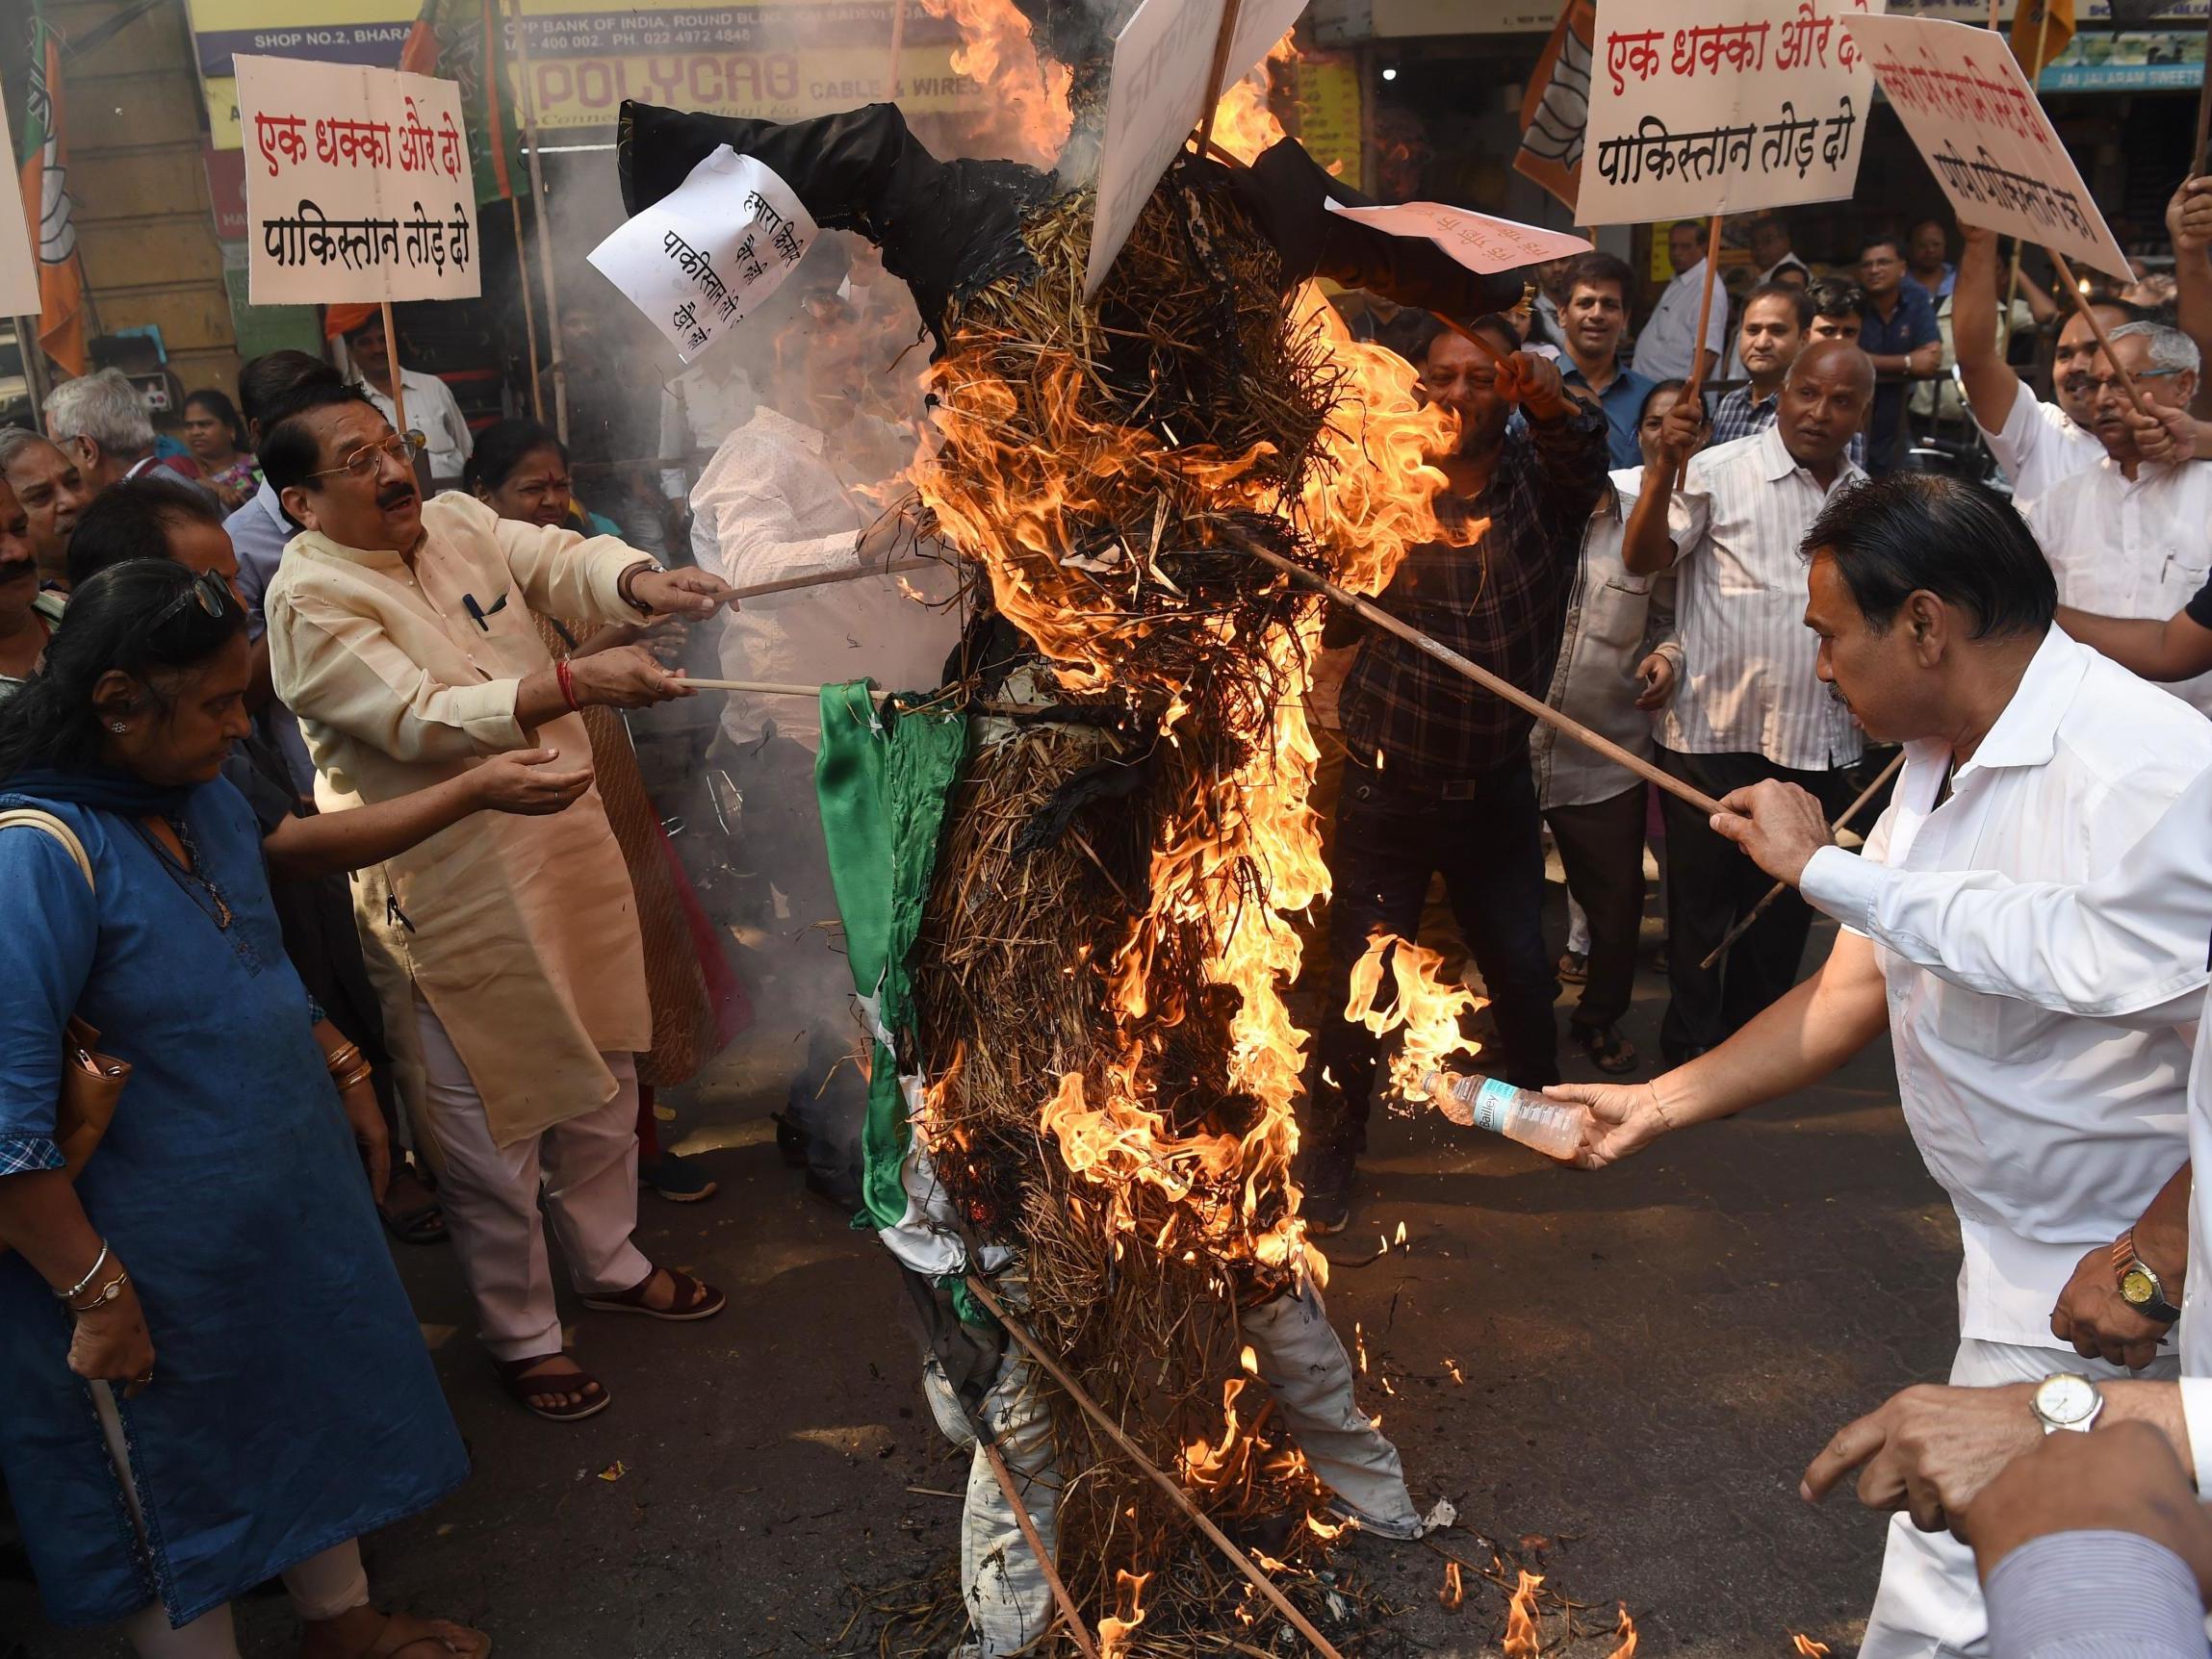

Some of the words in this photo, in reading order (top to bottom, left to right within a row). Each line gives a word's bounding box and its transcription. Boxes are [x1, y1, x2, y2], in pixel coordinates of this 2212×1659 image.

[254, 34, 301, 48] SHOP
[307, 31, 349, 46] NO.2,
[543, 19, 590, 33] BANK
[594, 17, 616, 31] OF
[674, 13, 732, 27] ROUND
[541, 37, 568, 49] 400
[612, 33, 638, 47] PH.
[644, 32, 671, 44] 022
[676, 30, 710, 43] 4972
[1608, 29, 1664, 96] एक
[1671, 20, 1771, 77] धक्का
[1776, 0, 1834, 70] और
[536, 53, 800, 111] POLYCAB
[810, 79, 881, 100] CABLE
[913, 76, 982, 98] WIRES
[2059, 72, 2080, 87] JAI
[2082, 70, 2146, 87] JALARAM
[2148, 68, 2202, 85] SWEETS
[2000, 64, 2052, 154] दो
[255, 111, 306, 177] एक
[316, 116, 392, 169] धक्का
[399, 96, 439, 175] और
[438, 112, 462, 183] दो
[1598, 115, 1757, 186] पाकिस्तान
[1762, 101, 1819, 180] तोड़
[1823, 95, 1856, 171] दो
[744, 190, 783, 235] हमारा
[263, 199, 399, 270] पाकिस्तान
[403, 201, 445, 277] तोड़
[448, 202, 470, 272] दो
[674, 301, 697, 338] खैर
[1479, 1094, 1499, 1128] Bailley
